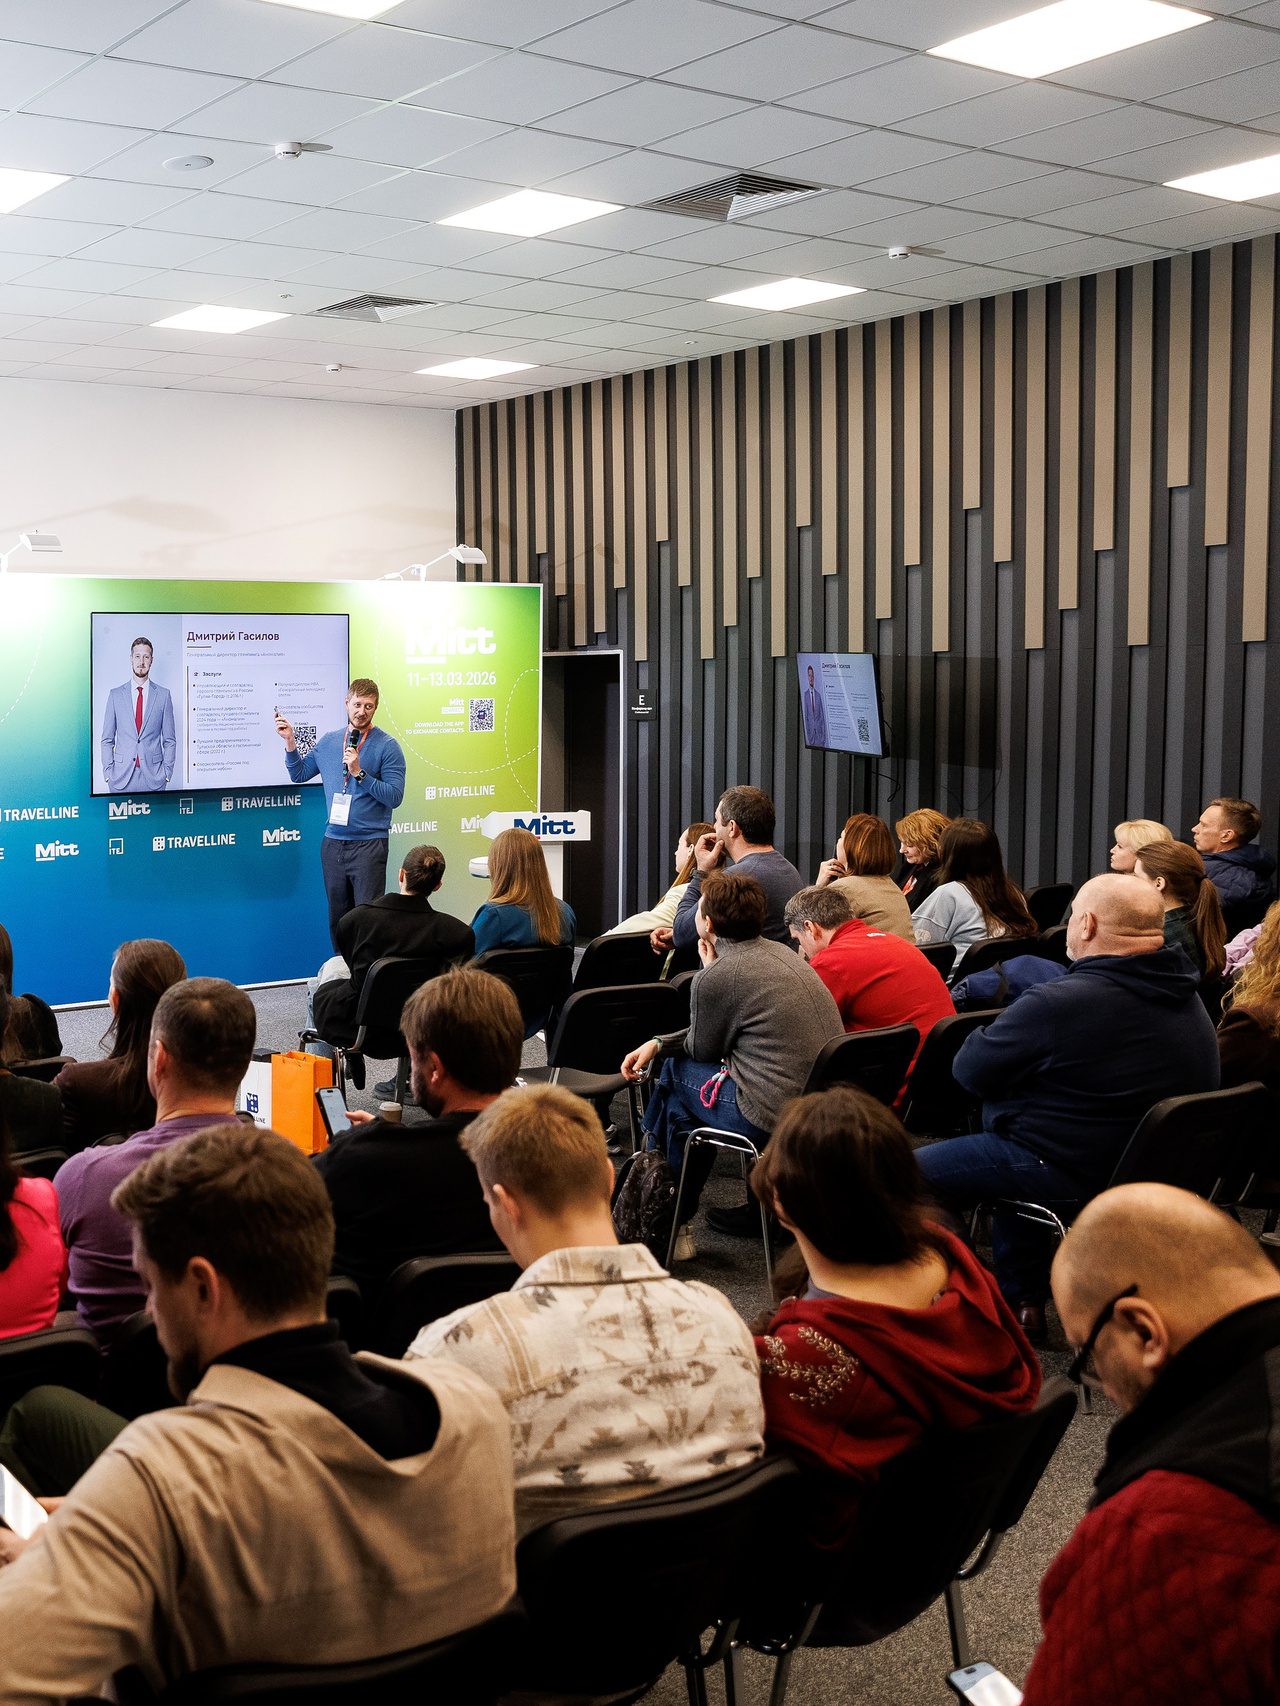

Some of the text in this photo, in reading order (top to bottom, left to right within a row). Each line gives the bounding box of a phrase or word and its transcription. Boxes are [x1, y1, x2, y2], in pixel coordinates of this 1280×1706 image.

[186, 631, 280, 642] Дмитрий Гасилов
[405, 617, 497, 656] Mitt
[437, 785, 495, 798] TRAVELLINE
[4, 805, 79, 822] TRAVELLINE
[108, 799, 151, 818] Mitt
[235, 795, 302, 809] TRAVELLINE
[389, 820, 438, 834] AVELLINE
[514, 815, 576, 836] Mitt
[167, 826, 301, 849] TRAVELLINE Mitt
[35, 840, 80, 859] Mitt
